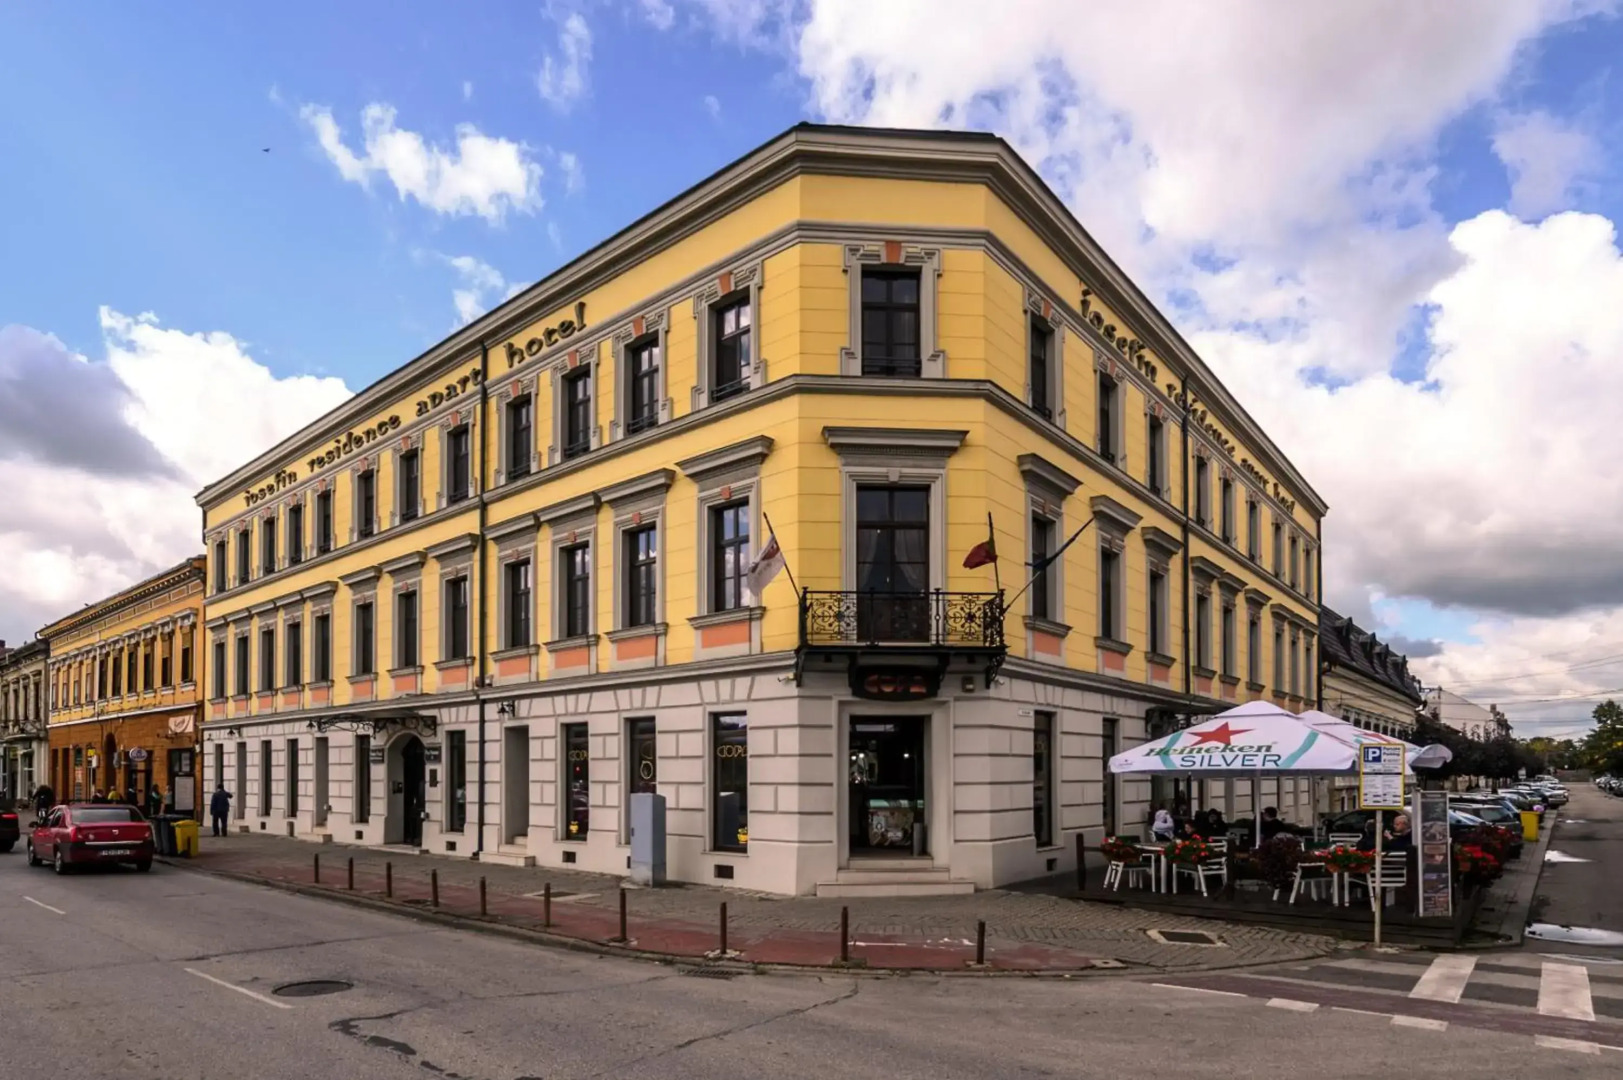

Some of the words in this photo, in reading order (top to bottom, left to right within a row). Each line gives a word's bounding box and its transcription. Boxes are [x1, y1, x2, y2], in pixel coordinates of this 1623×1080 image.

[307, 413, 402, 473] residence
[415, 367, 483, 417] apart
[503, 301, 588, 369] hotel
[1143, 743, 1274, 757] Heineken
[1180, 753, 1282, 767] SILVER
